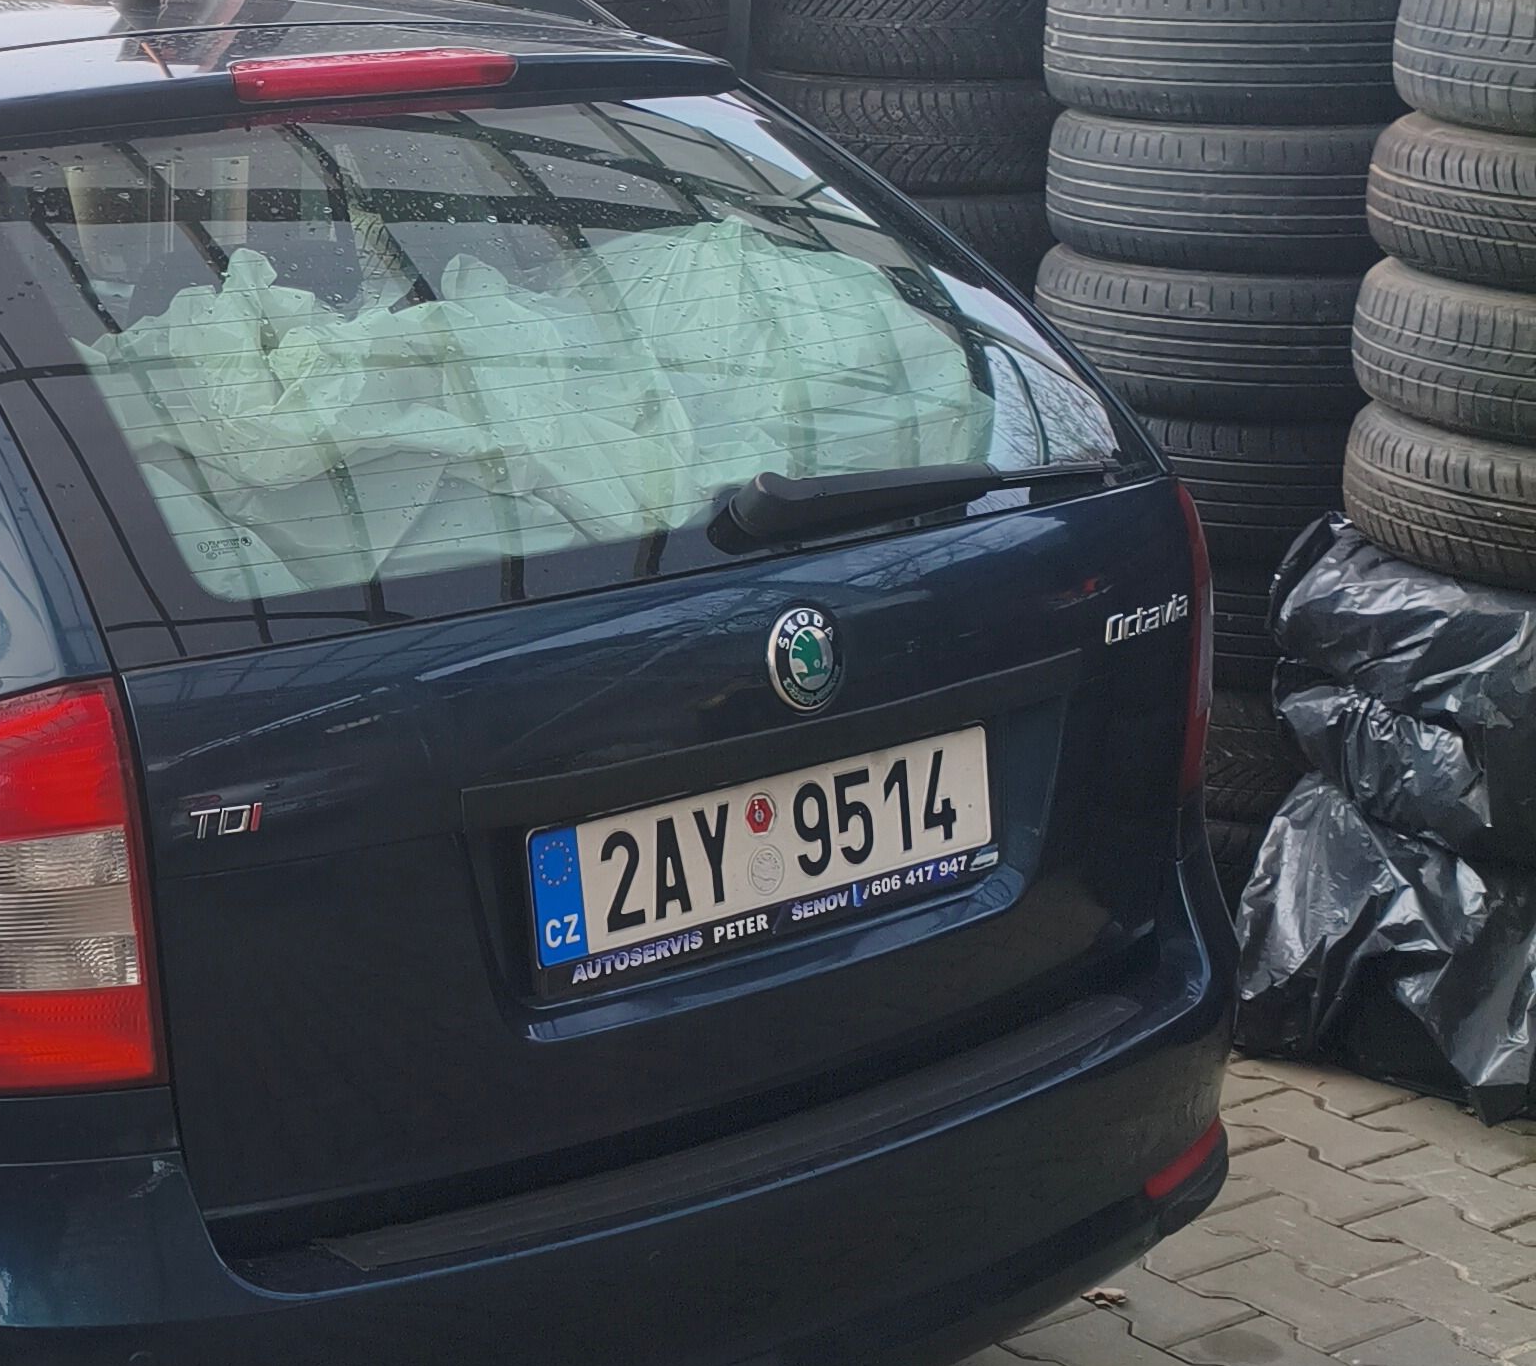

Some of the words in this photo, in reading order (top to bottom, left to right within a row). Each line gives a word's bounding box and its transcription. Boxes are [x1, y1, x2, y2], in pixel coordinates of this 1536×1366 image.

[1105, 594, 1188, 645] Octavia
[190, 802, 262, 839] TDI
[599, 802, 730, 934] 2AY
[792, 748, 957, 878] 9514
[546, 913, 581, 949] CZ
[572, 931, 703, 985] AUTOSERVIS
[714, 913, 769, 943] PETER
[791, 890, 849, 922] ŠENOV
[871, 874, 901, 896] 606
[905, 865, 934, 886] 417
[938, 855, 968, 877] 947
